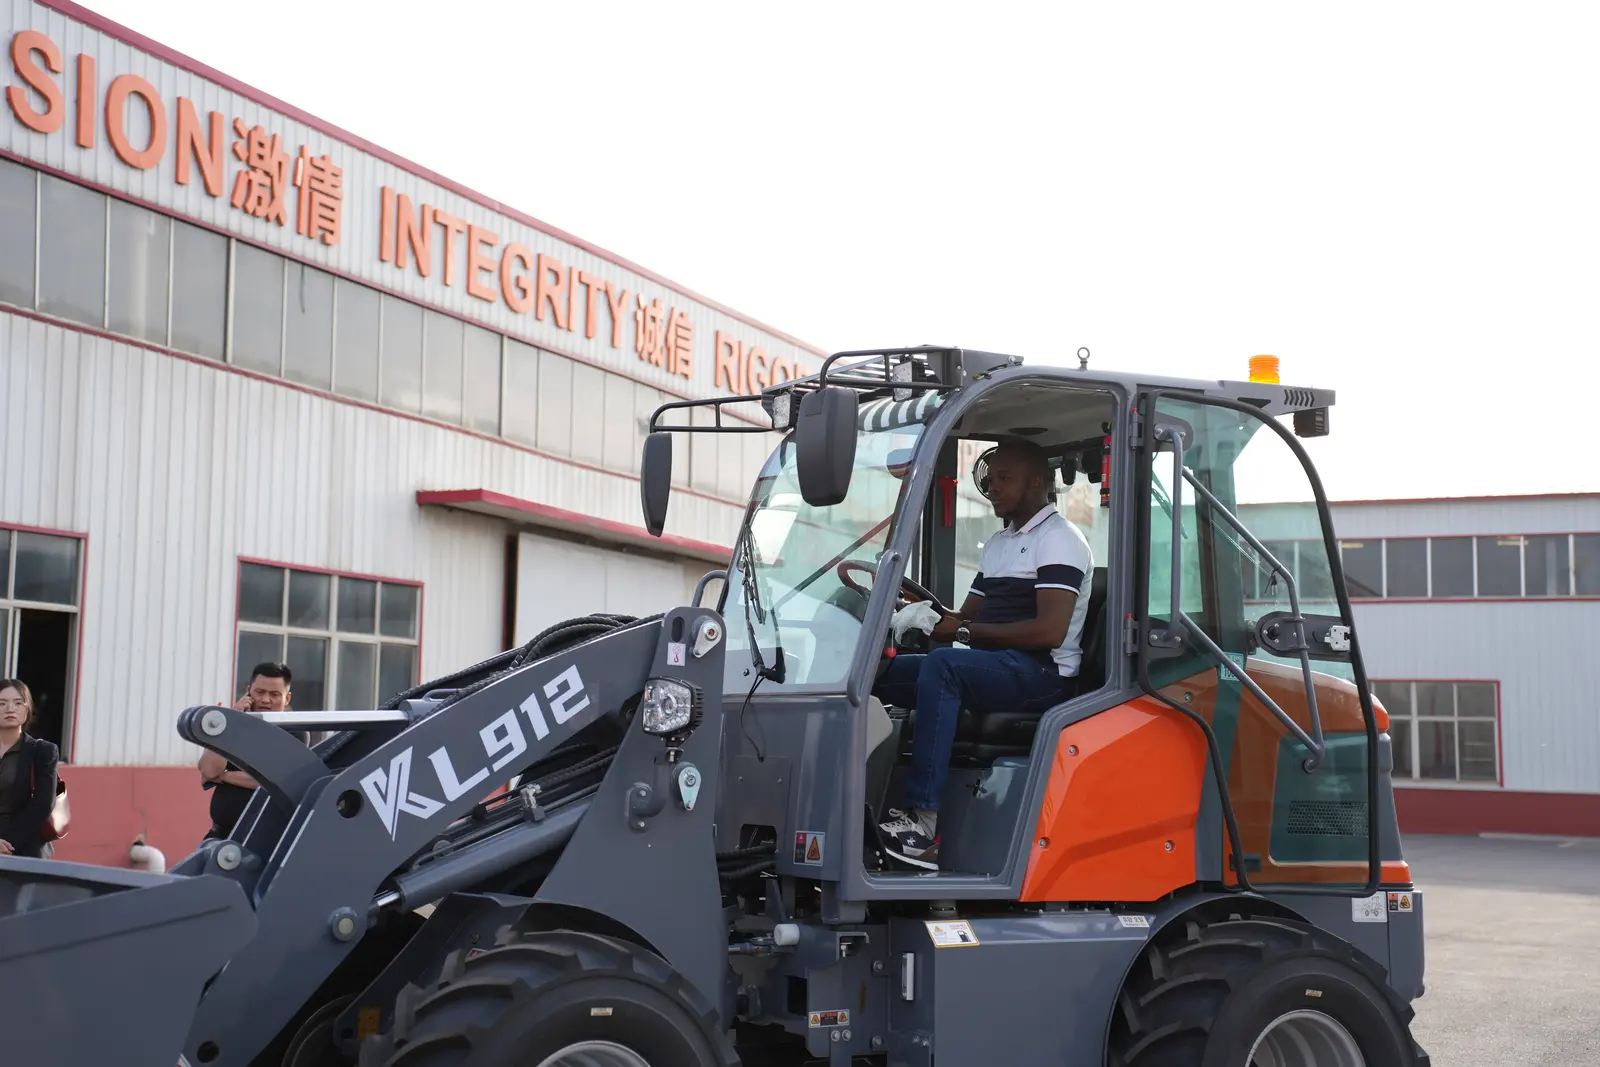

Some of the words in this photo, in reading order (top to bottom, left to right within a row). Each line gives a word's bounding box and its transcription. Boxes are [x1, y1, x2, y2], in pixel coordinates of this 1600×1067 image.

[6, 29, 225, 198] SION
[230, 116, 344, 246] 激情
[379, 185, 631, 348] INTEGRITY
[634, 292, 695, 380] 诚信
